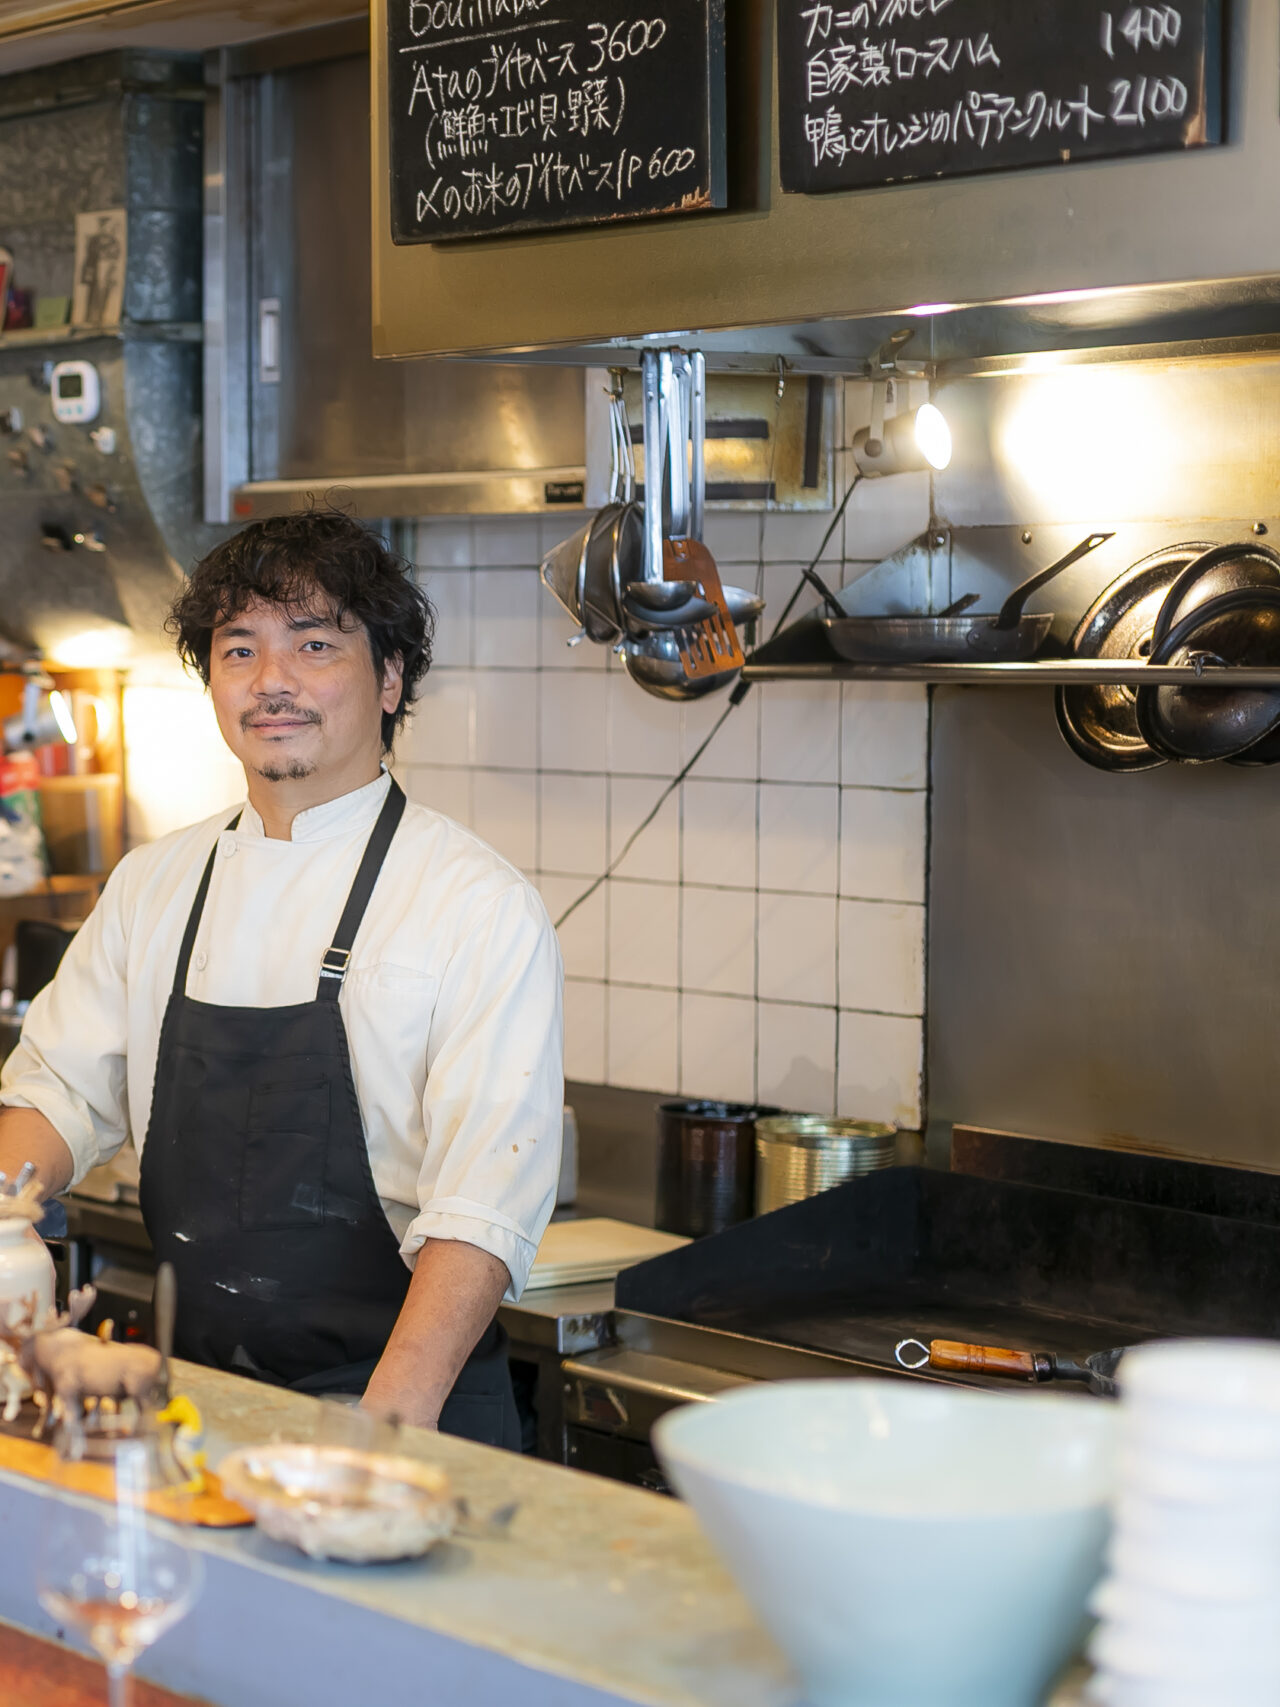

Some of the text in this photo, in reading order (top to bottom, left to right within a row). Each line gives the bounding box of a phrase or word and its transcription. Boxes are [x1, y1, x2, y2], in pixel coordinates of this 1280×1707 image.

[587, 18, 666, 72] 3600
[807, 4, 1182, 103] 自家製ロースハム 1400
[1110, 75, 1188, 126] 2100
[648, 146, 695, 180] 600
